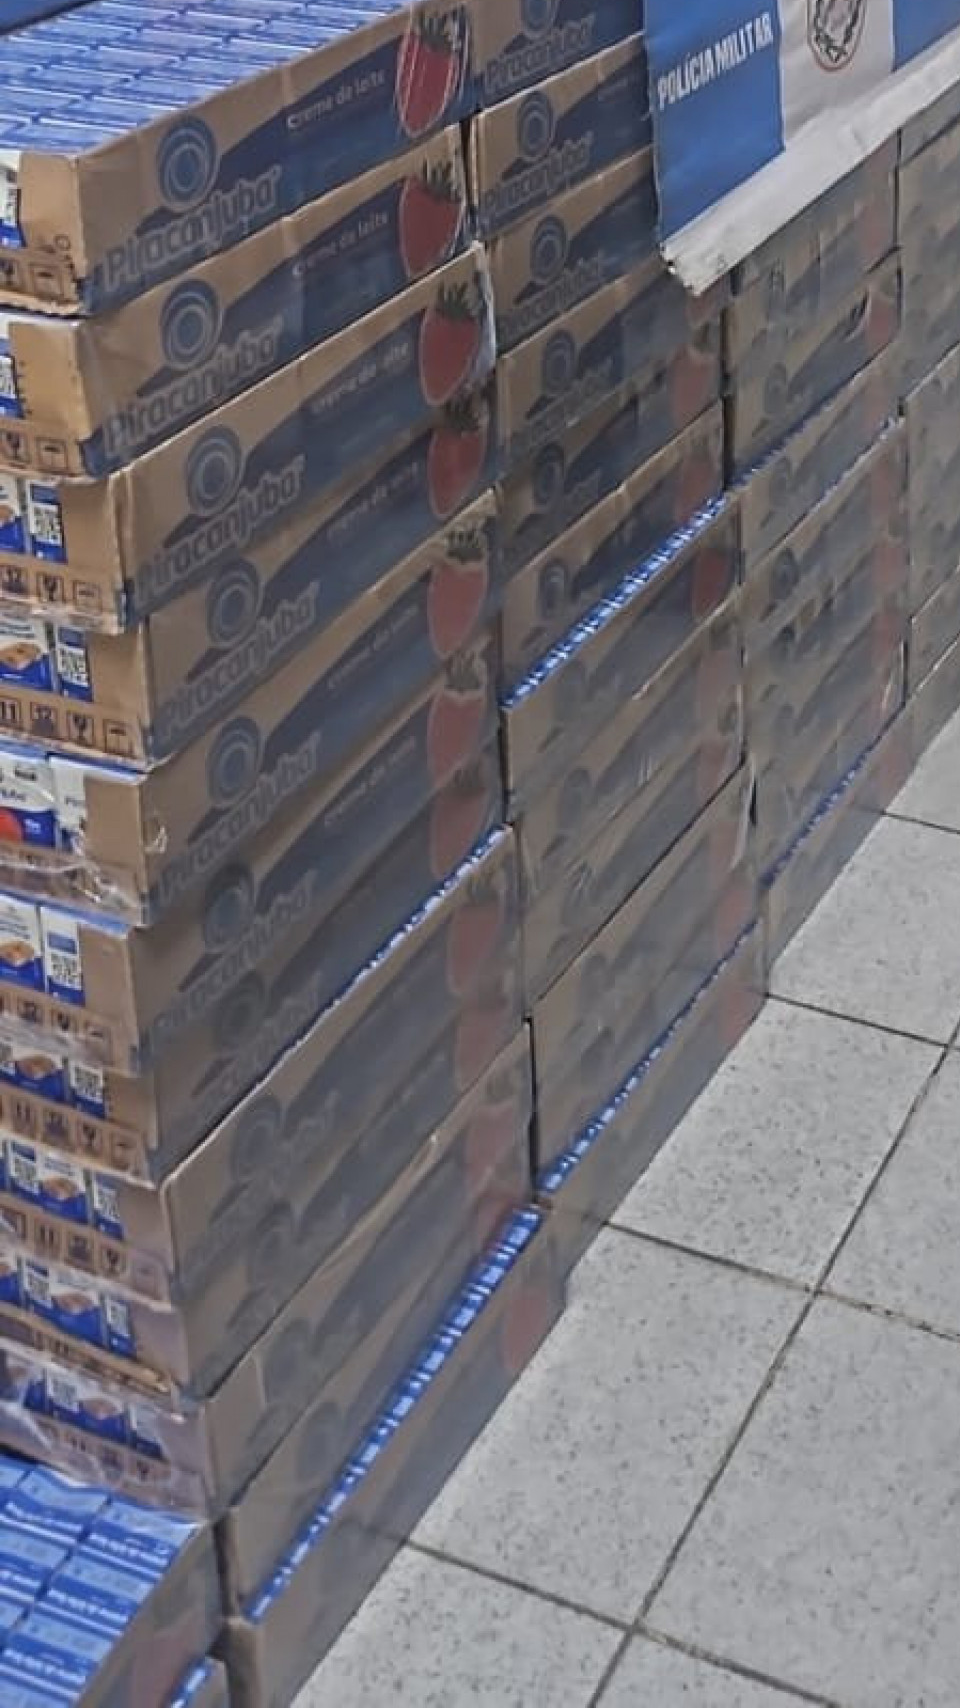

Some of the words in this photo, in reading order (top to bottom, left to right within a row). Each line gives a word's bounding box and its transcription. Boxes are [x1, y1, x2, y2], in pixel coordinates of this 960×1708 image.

[286, 94, 335, 130] creme
[334, 85, 355, 106] de
[355, 69, 386, 98] leite
[657, 47, 717, 112] POLÍCIA
[713, 11, 775, 76] MILITAR
[102, 164, 284, 295] Piracanjuba
[103, 314, 284, 461] Piracanjuba
[133, 453, 307, 614] Piracanjuba
